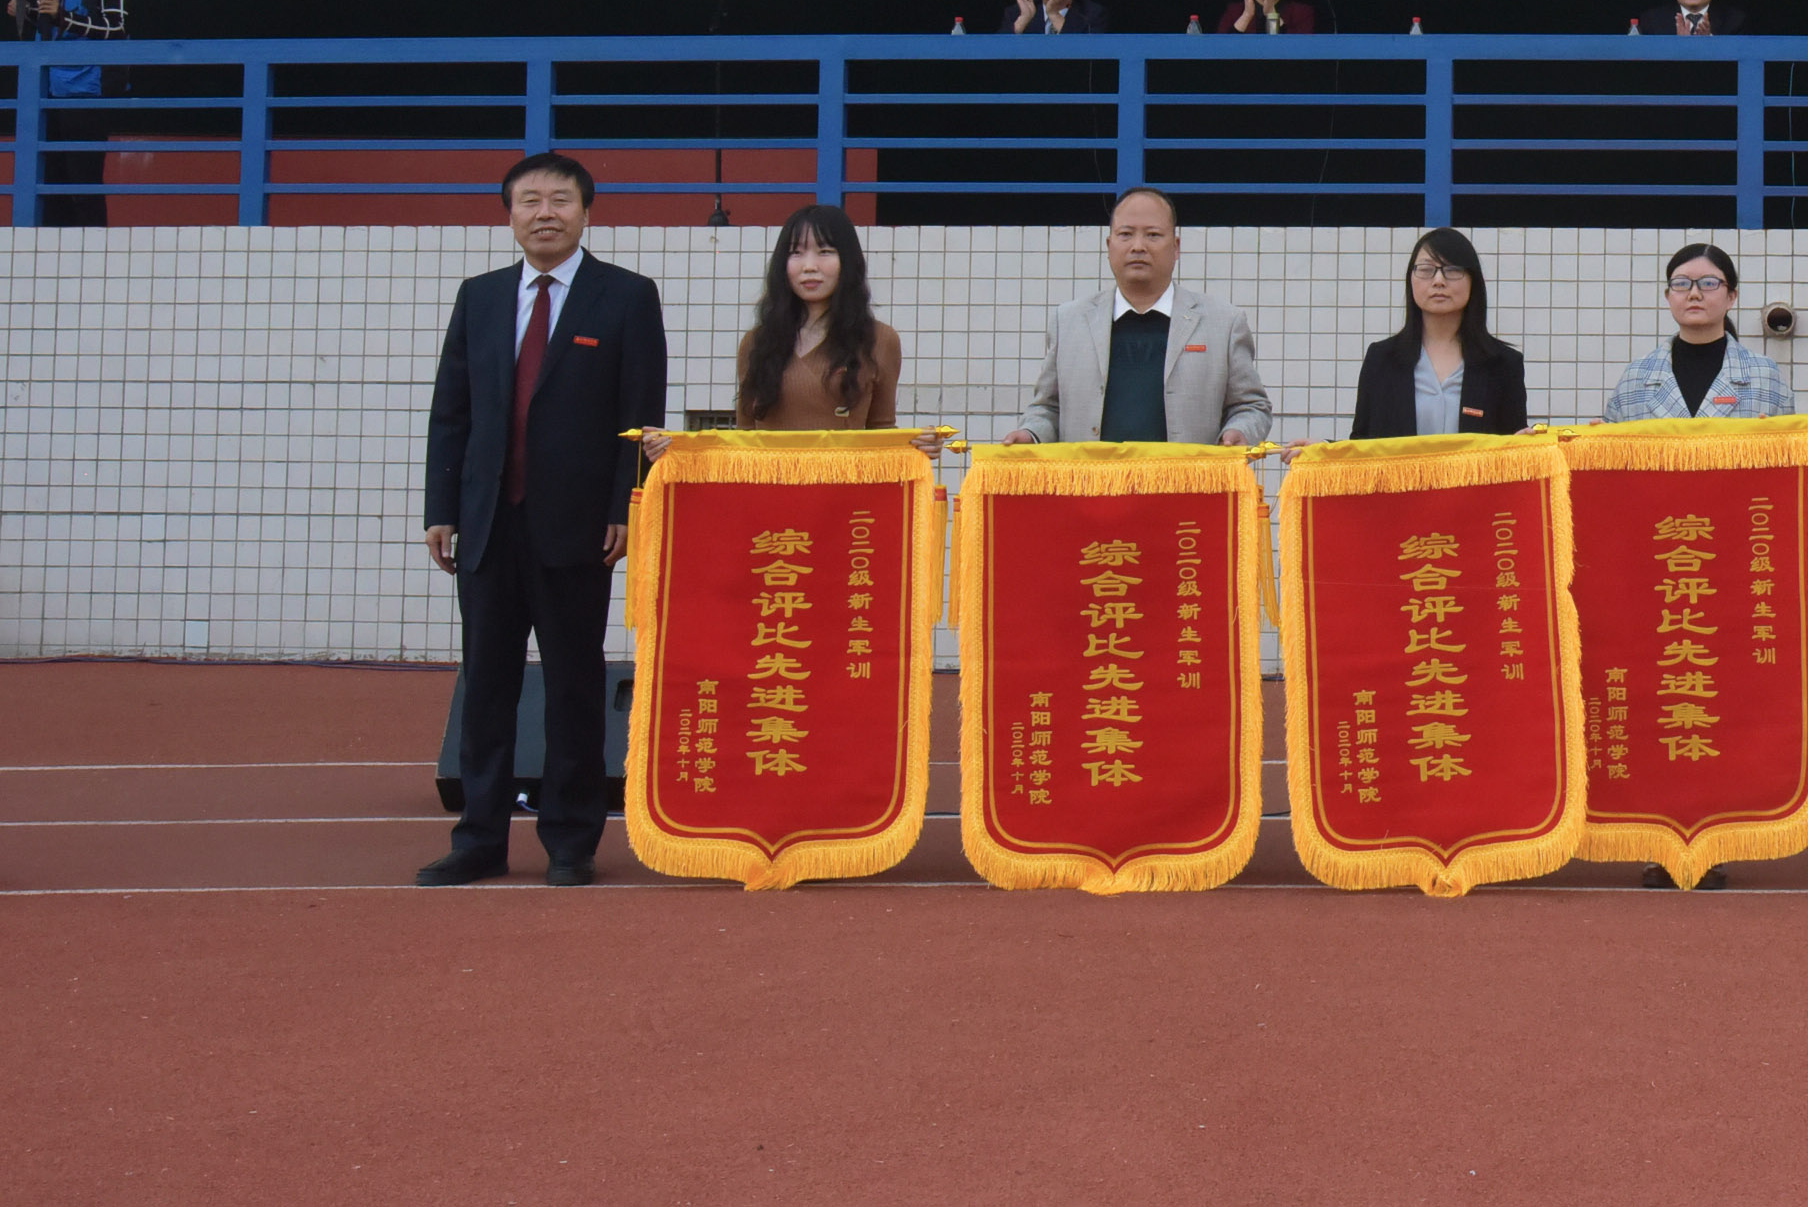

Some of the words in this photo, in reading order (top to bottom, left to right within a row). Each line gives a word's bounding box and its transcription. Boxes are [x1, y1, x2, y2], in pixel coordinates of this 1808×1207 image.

[746, 529, 813, 776] 综合评比先进集体
[1080, 540, 1144, 787] 综合评比先进集体
[1397, 533, 1472, 782] 综合评比先进集体
[1605, 667, 1630, 779] 南阳师范学院
[1653, 515, 1720, 761] 综合评比先进集体
[694, 679, 718, 793] 南阳师范学院
[1029, 691, 1053, 805] 南阳师范学院
[1353, 690, 1381, 803] 南阳师范学院
